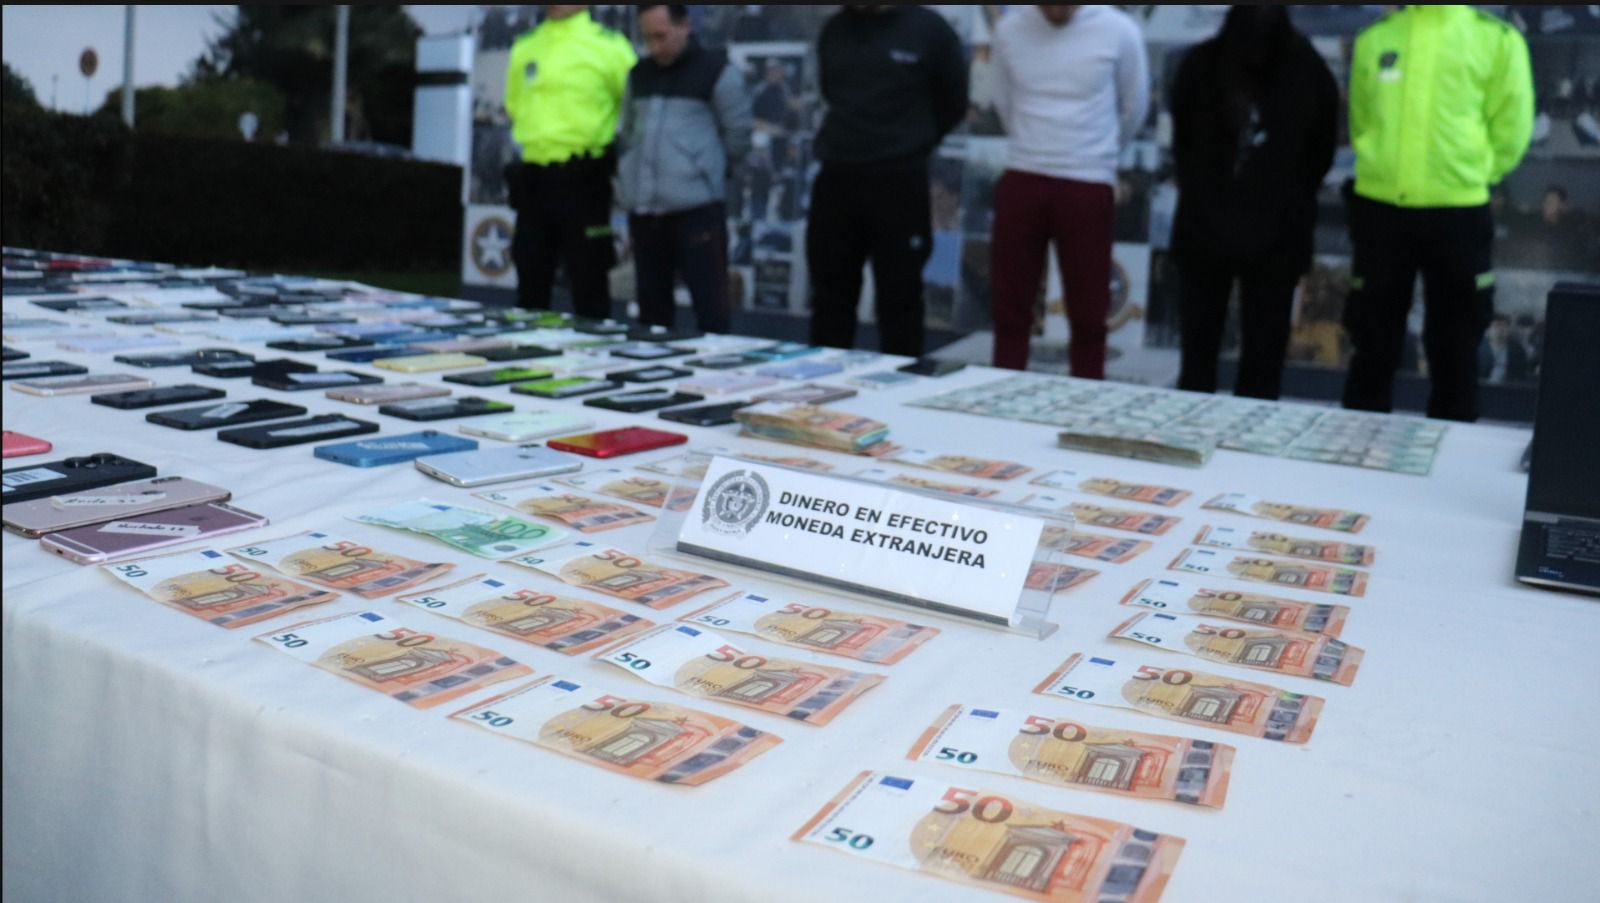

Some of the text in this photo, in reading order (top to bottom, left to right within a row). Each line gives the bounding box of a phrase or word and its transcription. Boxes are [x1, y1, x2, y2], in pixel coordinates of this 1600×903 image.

[778, 490, 988, 545] DINERO EN EFECTIVO
[491, 518, 547, 540] 100
[765, 510, 986, 569] MONEDA EXTRANJERA
[240, 546, 268, 558] 50
[323, 540, 374, 559] 50
[593, 549, 642, 569] 50
[516, 555, 545, 566] 50
[116, 563, 148, 579] 50
[208, 563, 262, 584] 50
[412, 596, 447, 610] 50
[502, 588, 557, 607] 50
[1138, 597, 1168, 609] 50
[1195, 588, 1243, 601] 50
[697, 614, 731, 627] 50
[776, 602, 833, 620] 50
[272, 632, 309, 649] 50
[374, 627, 435, 649] 50
[1129, 631, 1162, 644] 50
[1194, 623, 1247, 640] 50
[613, 651, 652, 671] 50
[705, 644, 769, 670] 50
[1132, 664, 1193, 686] 50
[1057, 685, 1095, 700] 50
[580, 694, 651, 719] 50
[471, 709, 515, 728] 50
[1018, 714, 1088, 742] 50
[935, 746, 978, 765] 50
[932, 786, 1014, 823] 50
[824, 826, 875, 850] 50
